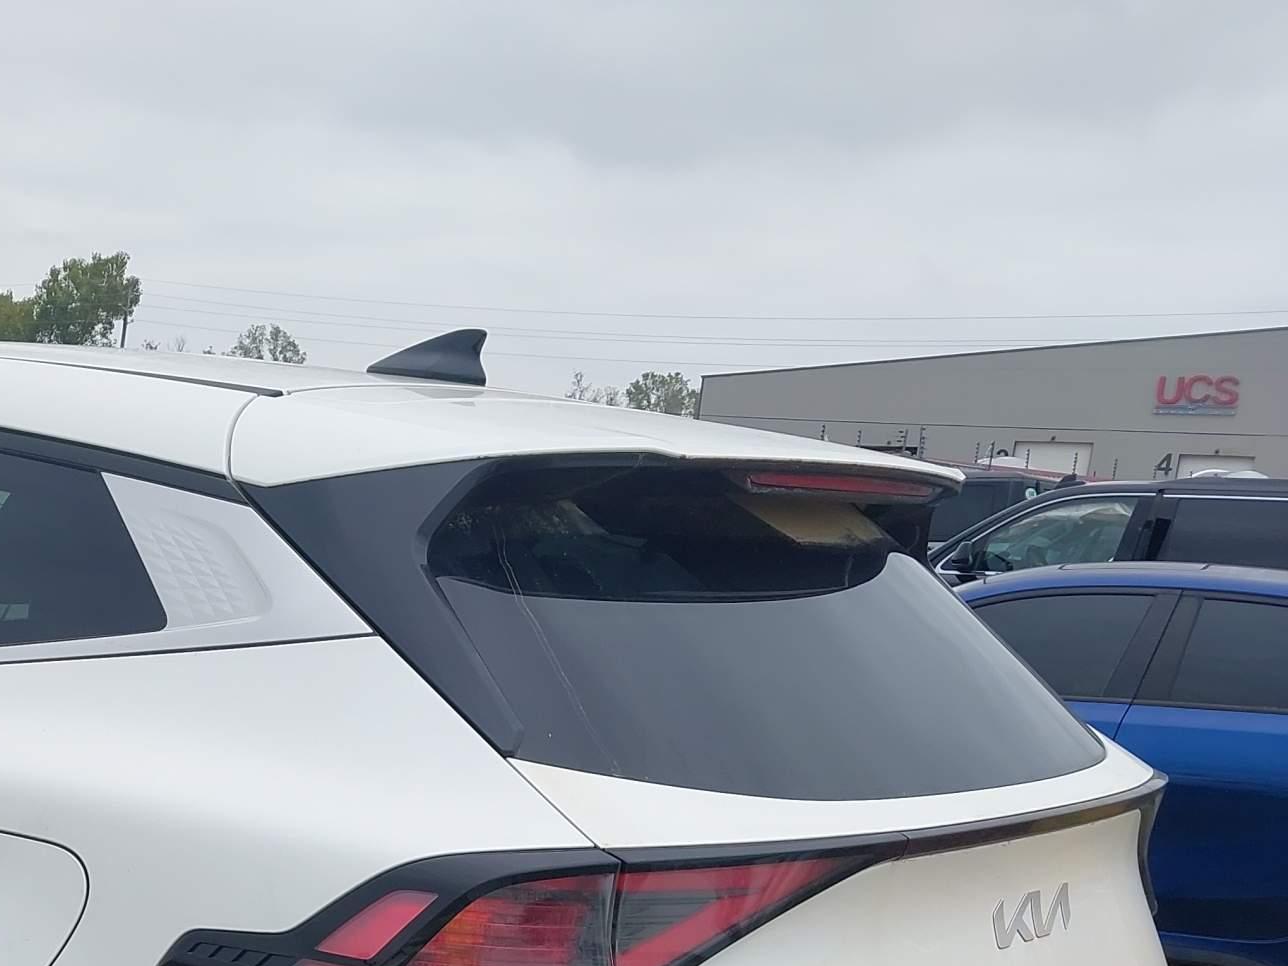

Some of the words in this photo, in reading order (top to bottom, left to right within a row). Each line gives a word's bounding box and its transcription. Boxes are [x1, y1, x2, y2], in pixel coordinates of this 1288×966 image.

[1156, 374, 1240, 407] UCS
[1155, 453, 1173, 476] 4
[992, 881, 1071, 950] KIA
